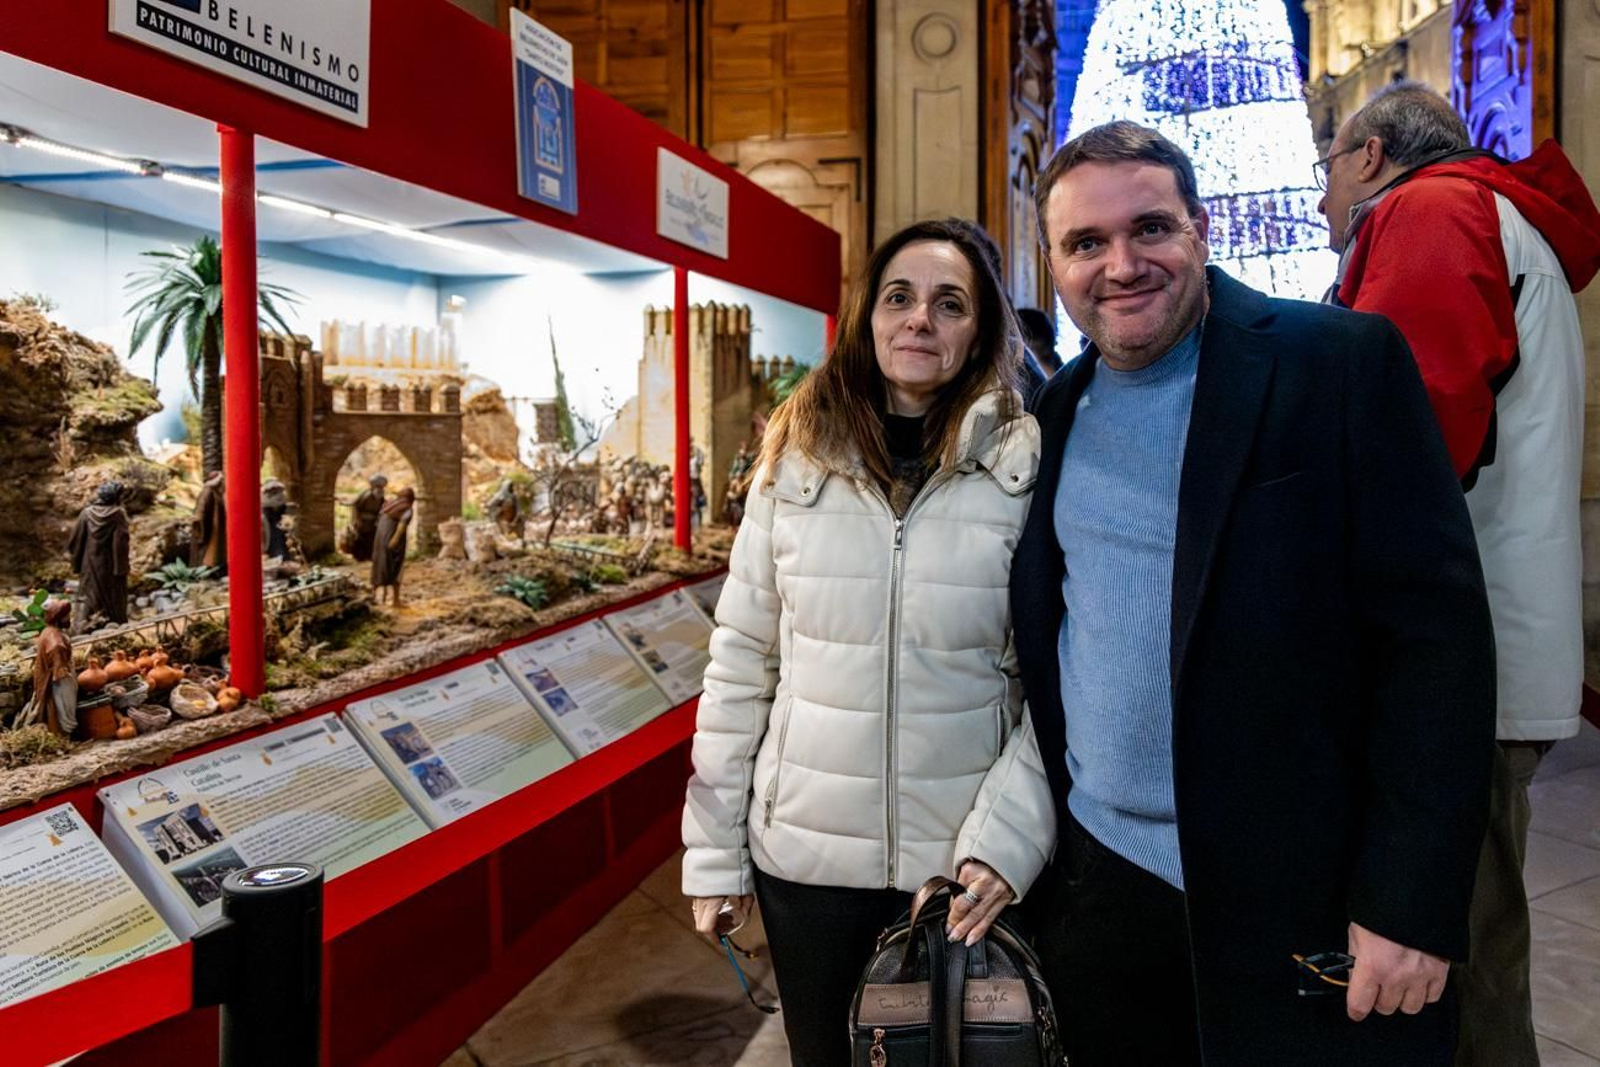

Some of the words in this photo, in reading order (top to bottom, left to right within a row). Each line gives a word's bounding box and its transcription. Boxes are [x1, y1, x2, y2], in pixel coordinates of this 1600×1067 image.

[139, 7, 228, 55] PATRIMONIO
[233, 46, 290, 81] CULTURAL
[294, 71, 357, 110] INMATERIAL
[208, 0, 359, 82] BELENISMO
